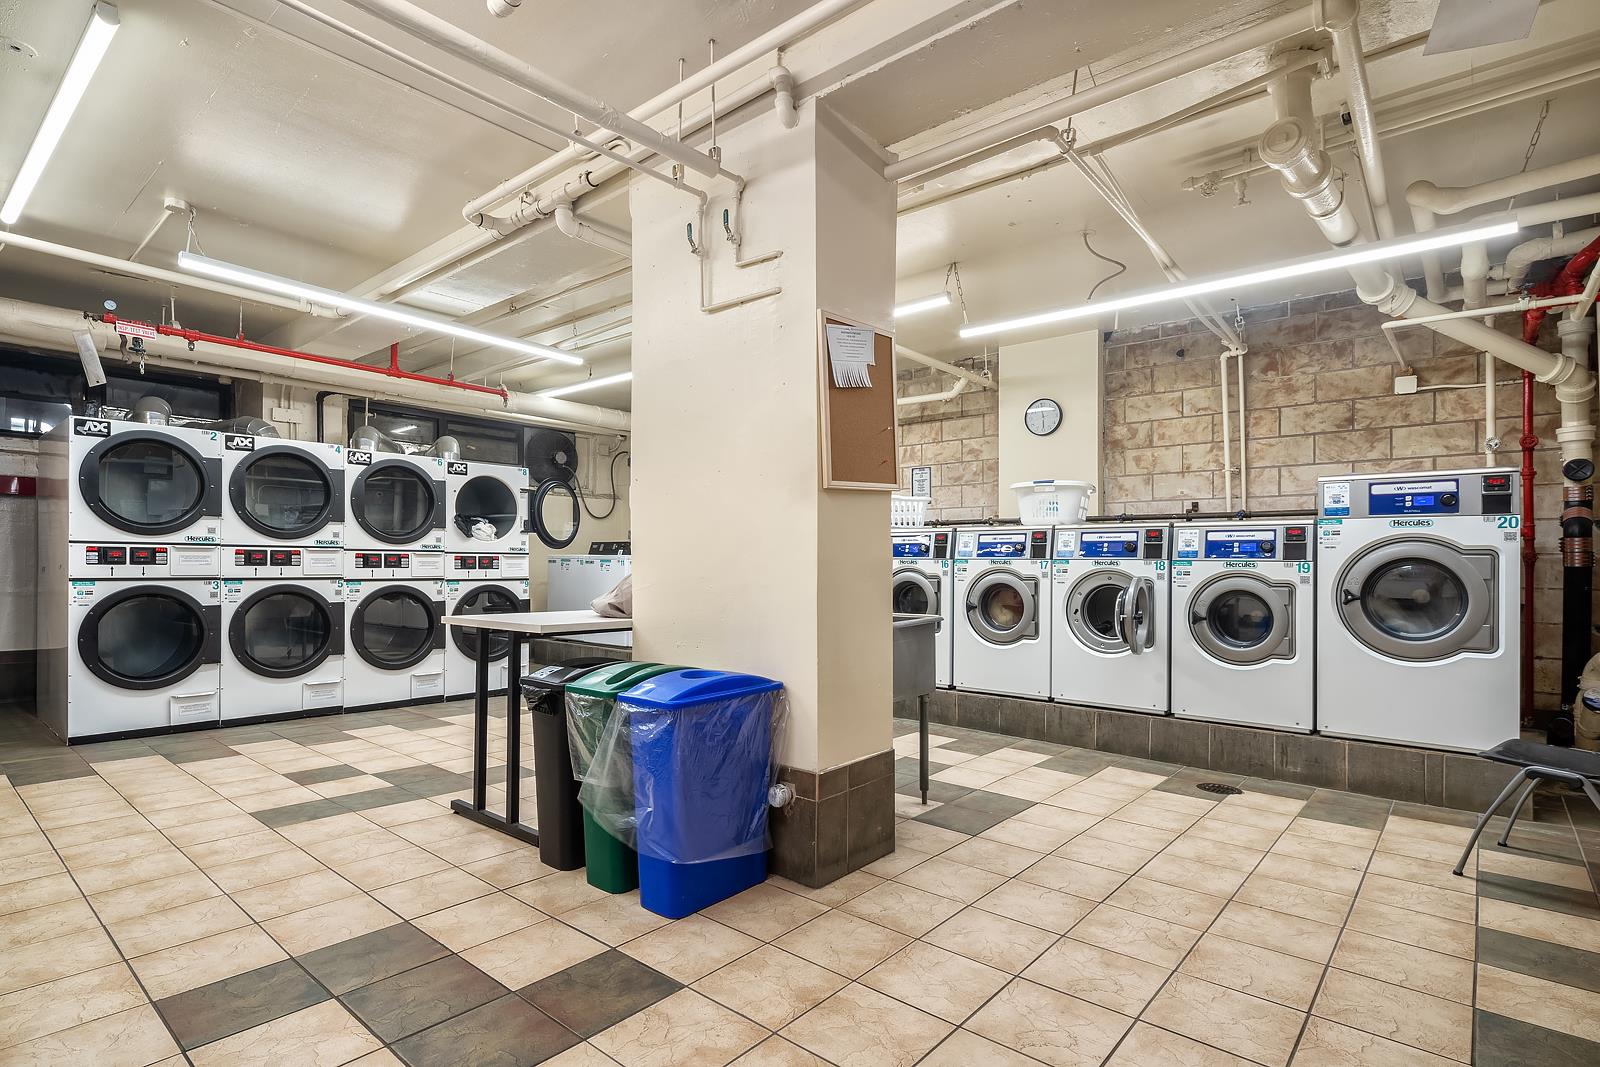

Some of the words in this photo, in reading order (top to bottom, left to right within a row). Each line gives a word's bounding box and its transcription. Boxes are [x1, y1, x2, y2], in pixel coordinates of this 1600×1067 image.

[84, 421, 108, 433] ADC
[210, 432, 217, 441] 2
[233, 437, 253, 447] ADC
[335, 446, 341, 454] 4
[1392, 519, 1431, 527] Hercules
[1497, 516, 1519, 529] 20
[941, 560, 949, 569] 16
[1039, 561, 1049, 570] 17
[1154, 560, 1166, 571] 18
[1296, 562, 1311, 573] 19
[213, 580, 219, 590] 3
[338, 580, 343, 588] 5
[440, 580, 444, 588] 7
[524, 580, 529, 588] 9
